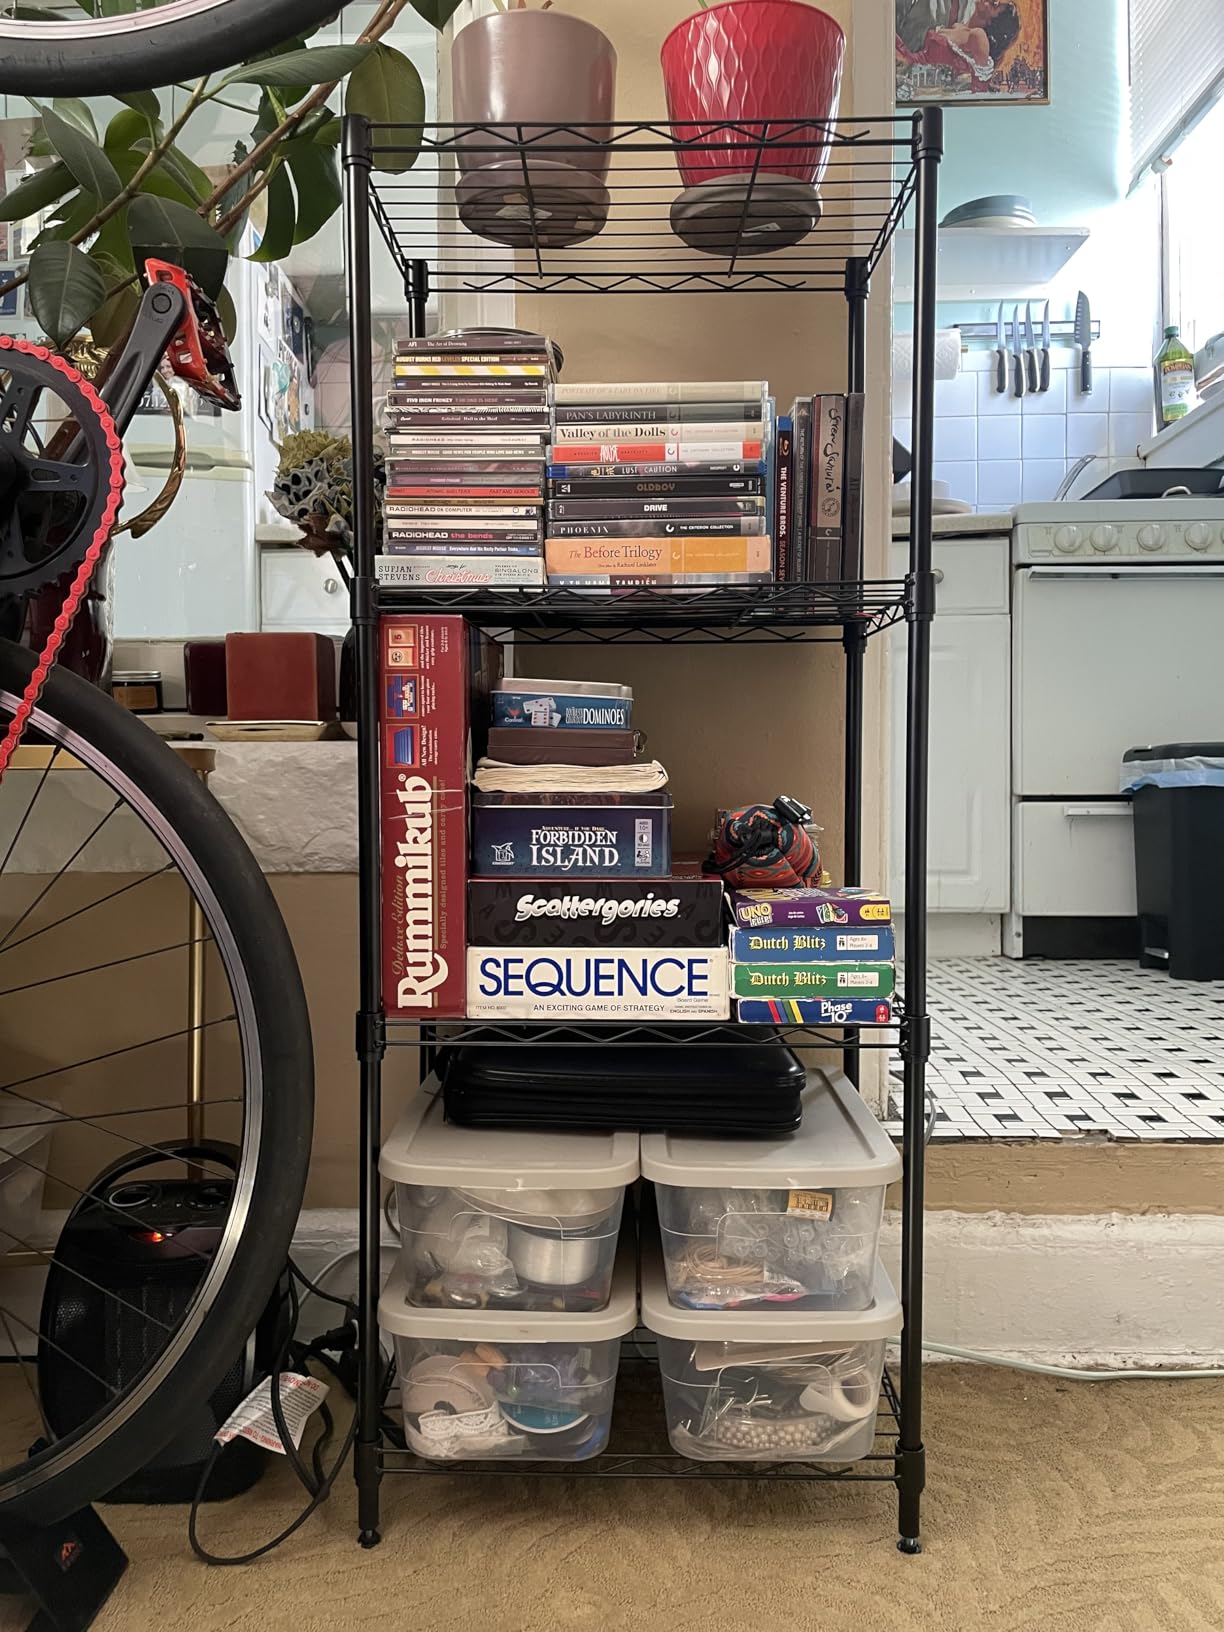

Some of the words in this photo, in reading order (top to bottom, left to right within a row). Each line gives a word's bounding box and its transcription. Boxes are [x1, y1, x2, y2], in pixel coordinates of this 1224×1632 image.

[566, 411, 594, 420] PAN'S
[596, 411, 656, 420] LABYRINTH
[560, 428, 596, 440] Valley
[598, 428, 612, 438] of
[613, 428, 632, 437] the
[634, 427, 666, 437] Dolls
[828, 407, 842, 446] Seven
[622, 466, 638, 474] LUST
[644, 465, 678, 473] CAUTION
[823, 443, 841, 493] Samurai
[636, 483, 676, 492] OLDBOY
[644, 504, 668, 512] DRIVE
[560, 526, 609, 534] PHOENIX
[779, 515, 787, 538] BROS.
[569, 550, 581, 558] The
[584, 545, 621, 559] Before
[621, 545, 662, 561] Trilogy
[378, 565, 412, 573] SUFJAN
[425, 567, 491, 584] Christmas
[583, 708, 625, 725] DOMINOES
[530, 829, 618, 846] FORBIDDEN
[529, 845, 619, 871] ISLAND
[391, 875, 404, 923] Edition
[394, 776, 449, 1009] Rummikub
[514, 893, 681, 926] Scattergories
[738, 902, 773, 922] UNO
[392, 924, 404, 976] Deluxe
[749, 935, 789, 950] Dutch
[793, 935, 826, 950] Blitz
[479, 957, 709, 997] SEQUENCE
[750, 971, 789, 986] Dutch
[793, 971, 827, 986] Blitz
[533, 1004, 545, 1012] AN
[547, 1004, 584, 1012] EXCITING
[585, 1004, 609, 1012] GAME
[623, 1004, 665, 1012] STRATEGY
[821, 1000, 853, 1014] Phase
[831, 1010, 847, 1023] 10
